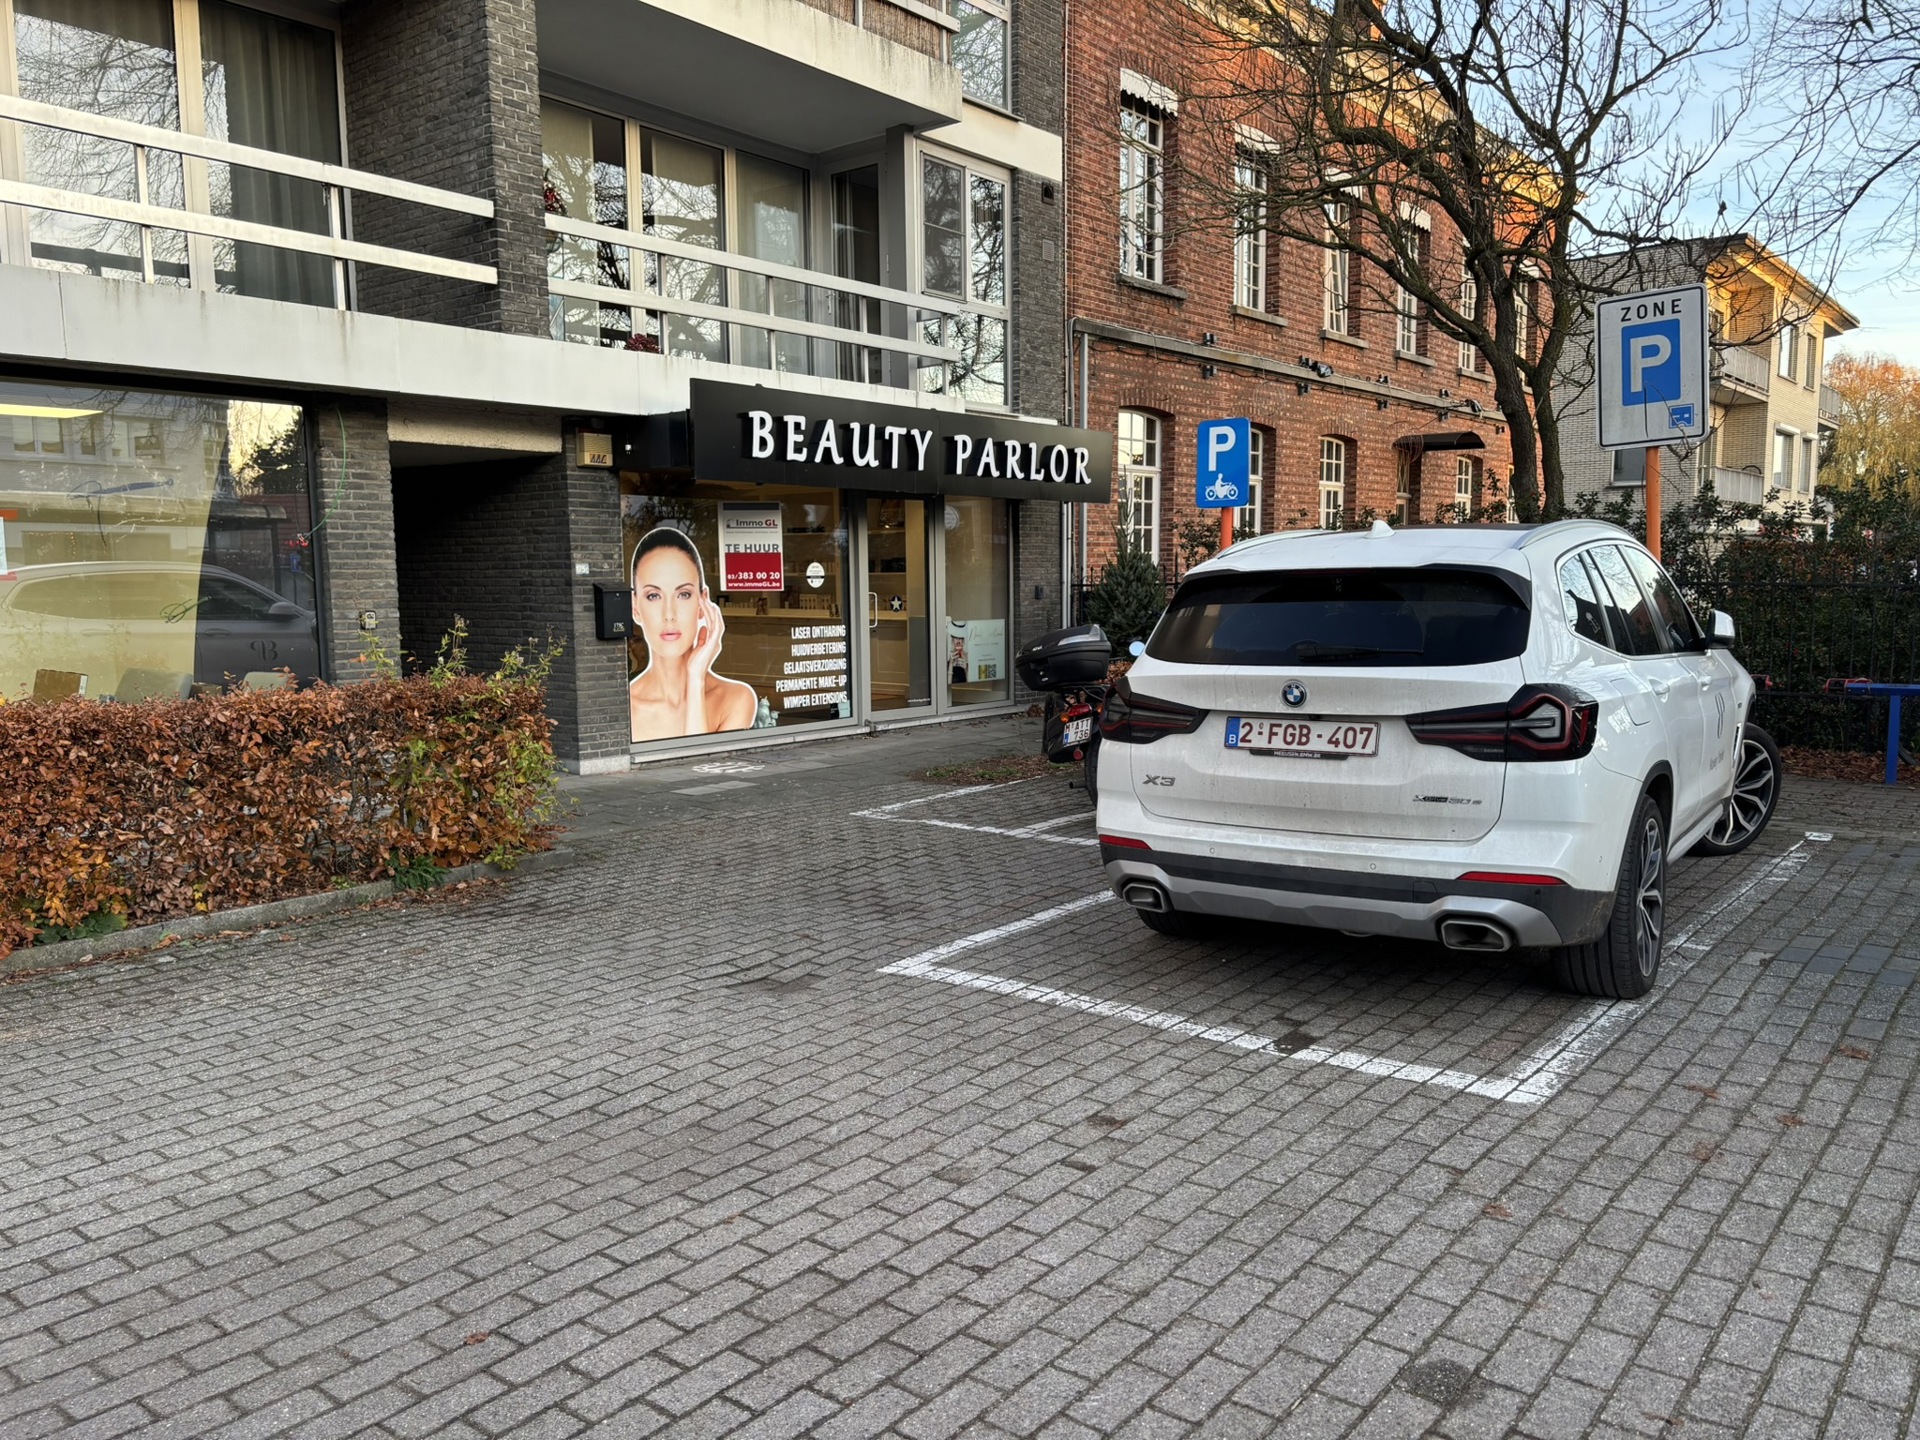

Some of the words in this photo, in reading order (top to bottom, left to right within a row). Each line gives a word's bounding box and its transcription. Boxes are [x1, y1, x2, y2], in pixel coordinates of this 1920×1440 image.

[1620, 298, 1682, 322] ZONE
[1630, 334, 1672, 393] P
[749, 410, 934, 471] BEAUTY
[953, 434, 1092, 485] PARLOR
[1208, 426, 1236, 472] P
[735, 519, 763, 527] Immo
[765, 519, 778, 527] GL
[725, 544, 740, 553] TE
[744, 543, 780, 553] HUUR
[756, 572, 767, 580] 00
[769, 572, 780, 580] 20
[791, 626, 811, 639] LASER
[812, 625, 846, 638] ONTHARING
[791, 641, 847, 657] HUIDVERBETERING
[783, 658, 847, 674] GELAATSVERZORGING
[775, 677, 818, 692] PERMANENTE
[818, 675, 847, 689] MAKE-UP
[783, 695, 810, 709] WIMPER
[811, 691, 848, 706] EXTENSIONS
[1074, 730, 1089, 740] 736
[1228, 734, 1237, 744] B
[1240, 722, 1373, 749] 2-FGB-407
[1142, 774, 1176, 786] X3
